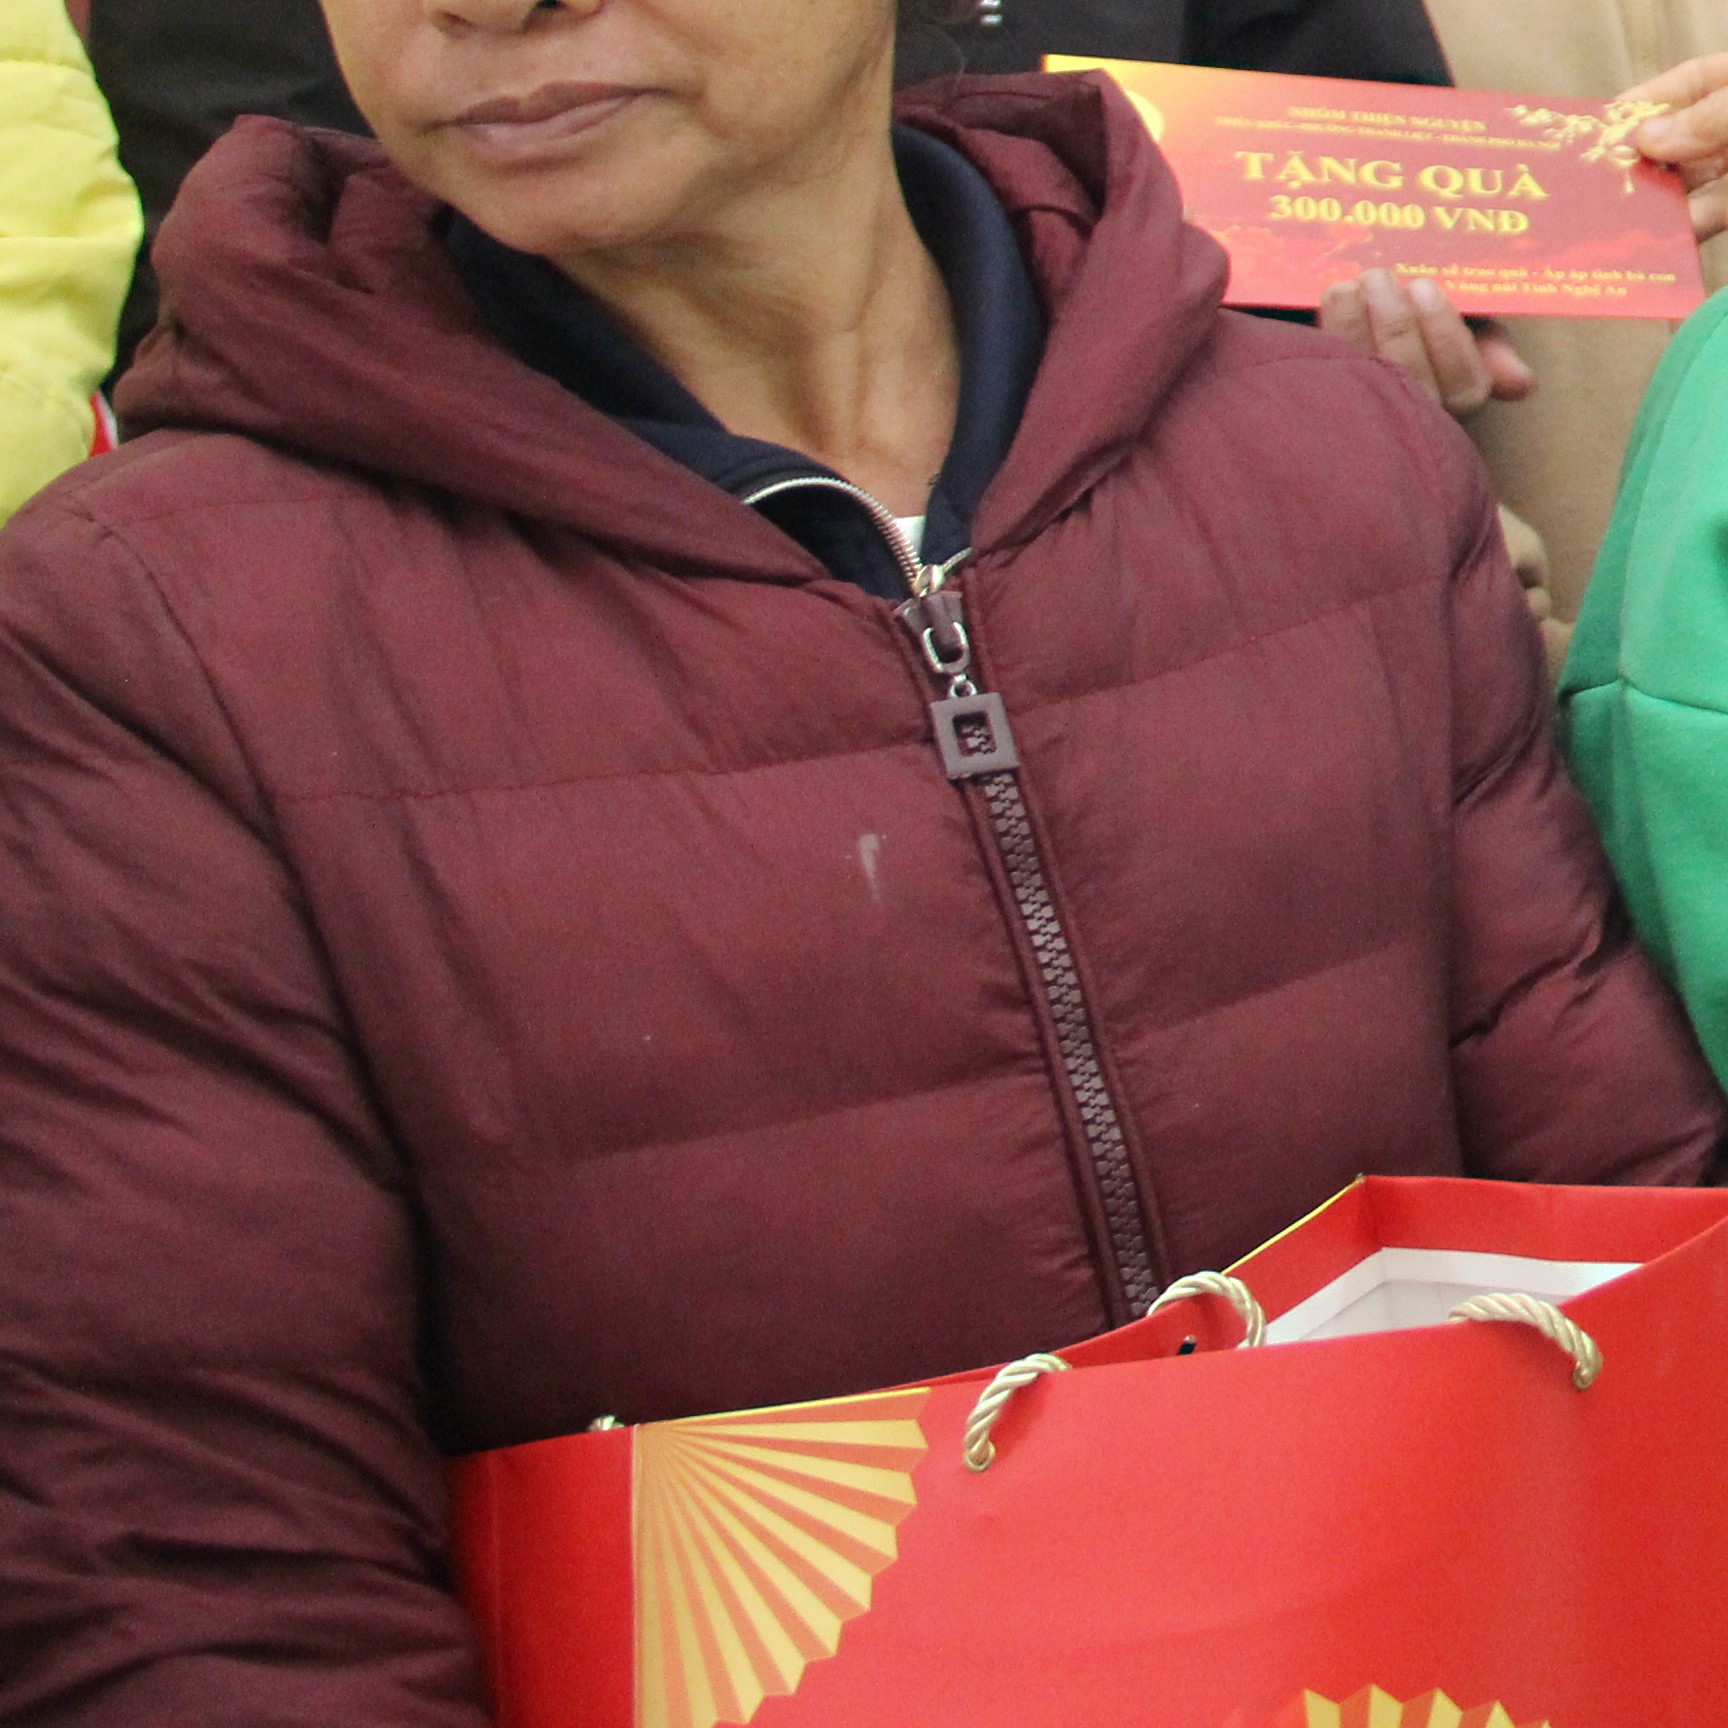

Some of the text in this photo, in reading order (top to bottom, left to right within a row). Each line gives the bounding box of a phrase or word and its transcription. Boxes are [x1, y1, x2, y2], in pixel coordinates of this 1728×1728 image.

[1235, 150, 1549, 199] TẶNG QUÀ
[1269, 193, 1530, 236] 300.000 VNĐ
